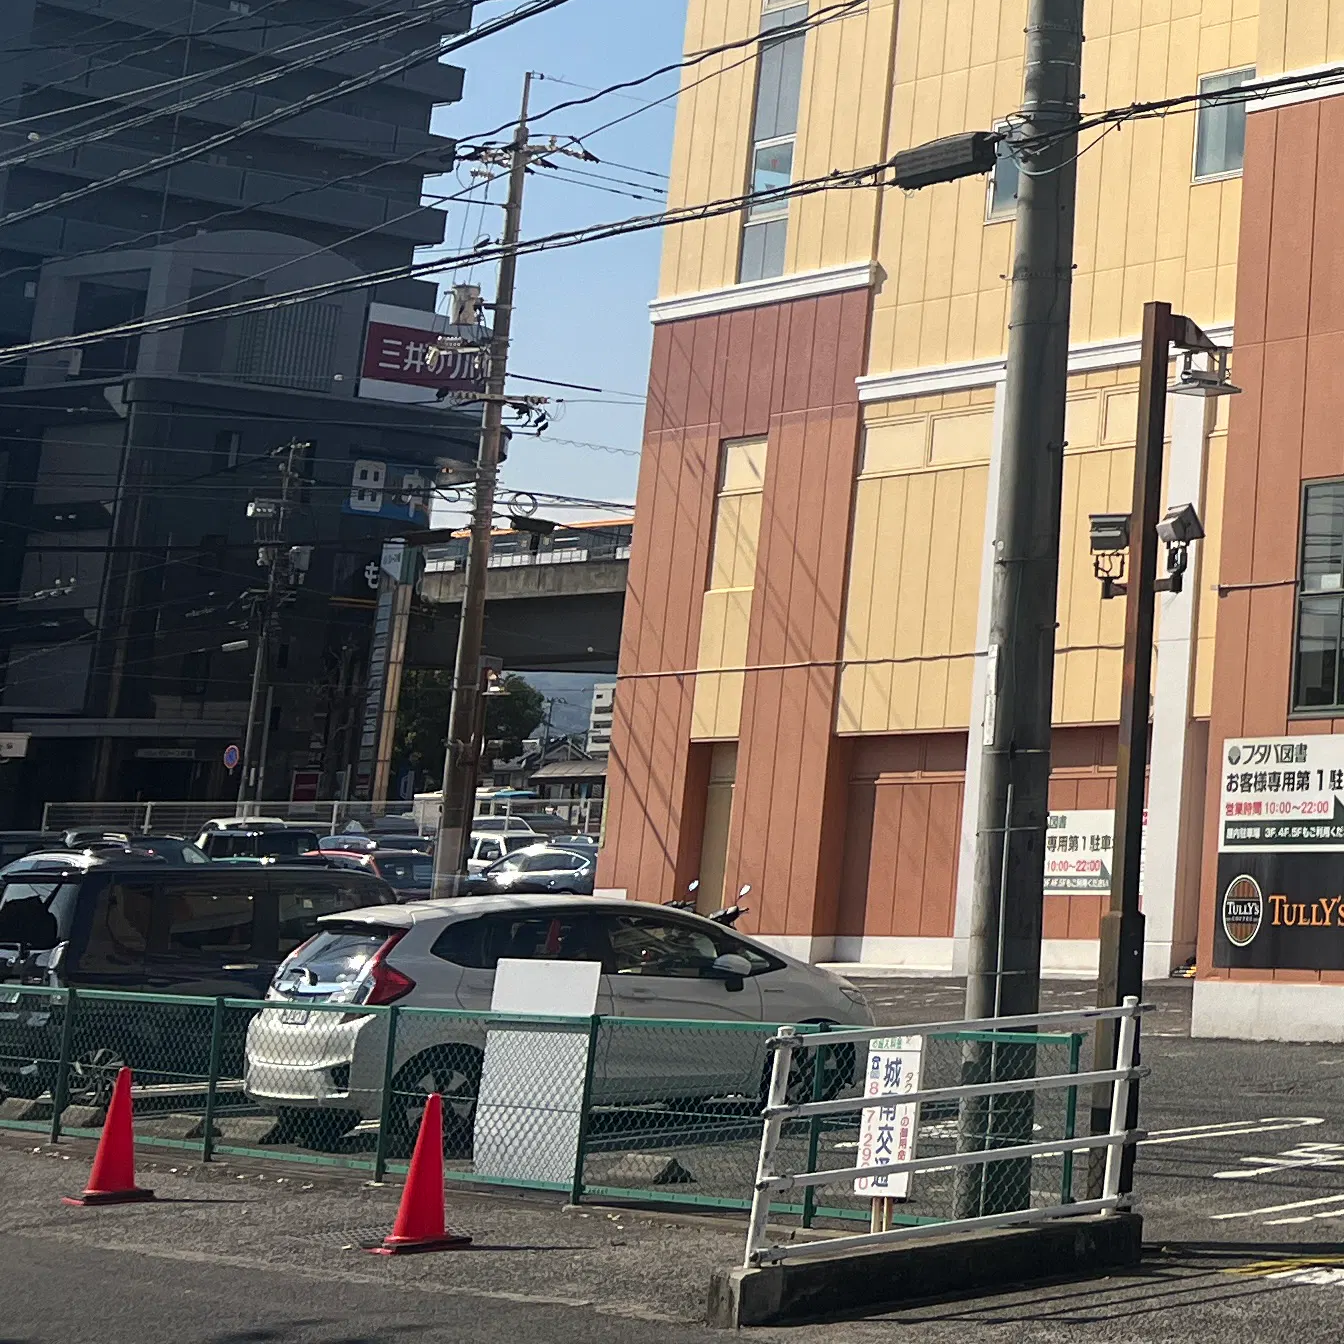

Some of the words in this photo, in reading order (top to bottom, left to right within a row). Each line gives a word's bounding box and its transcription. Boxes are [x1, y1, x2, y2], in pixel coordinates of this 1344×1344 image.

[1241, 742, 1308, 765] フタバ図書
[1046, 834, 1114, 853] 専用第1駐車
